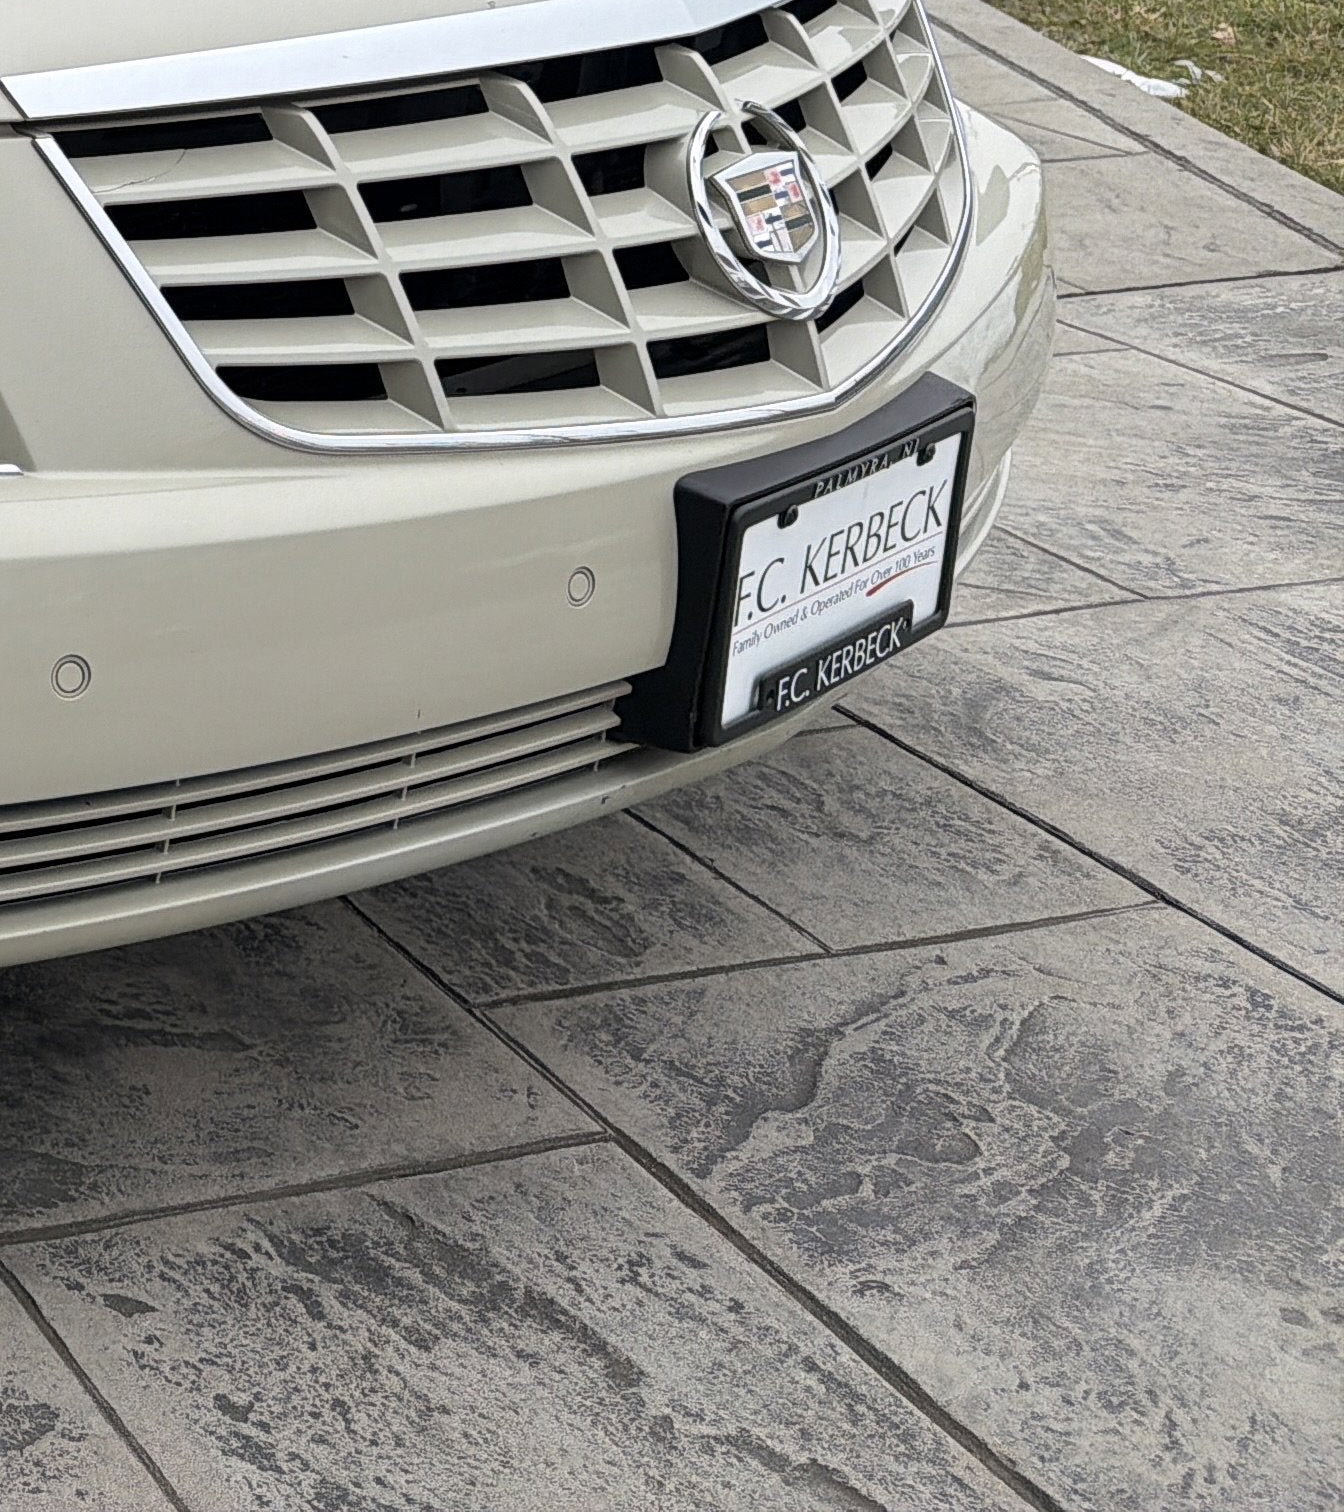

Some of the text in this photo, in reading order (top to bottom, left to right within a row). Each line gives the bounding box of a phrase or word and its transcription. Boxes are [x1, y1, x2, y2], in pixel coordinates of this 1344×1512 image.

[813, 453, 894, 500] PALMYRA,
[733, 478, 948, 628] F.C. KERBECK
[731, 545, 936, 657] Family Owned & Operated For Over 100 Years
[776, 667, 811, 712] F.C.
